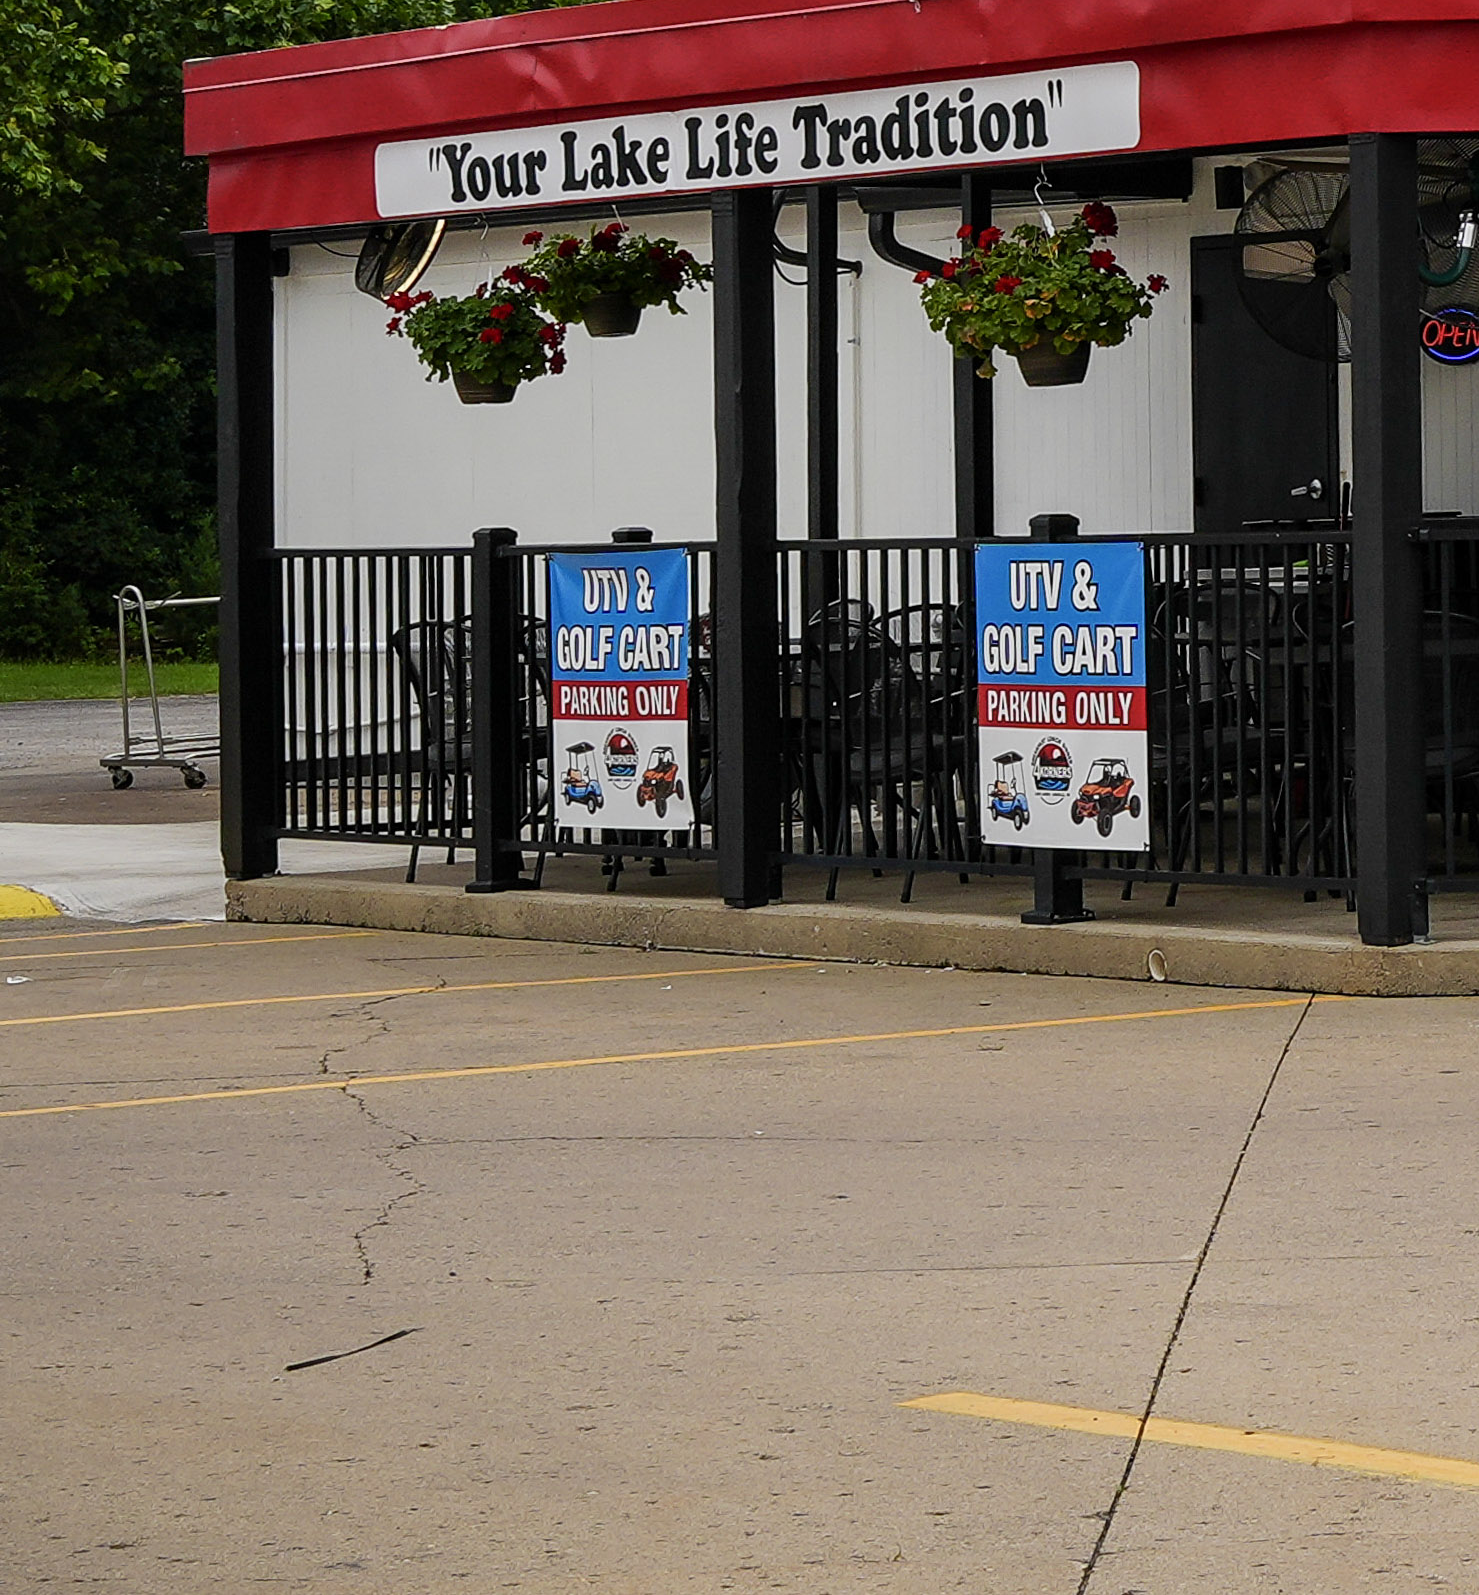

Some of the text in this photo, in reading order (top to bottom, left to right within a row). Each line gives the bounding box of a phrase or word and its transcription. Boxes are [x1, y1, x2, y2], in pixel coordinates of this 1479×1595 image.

[560, 125, 669, 192] Lake
[684, 112, 778, 180] Life
[793, 79, 1062, 169] Tradition"
[582, 566, 655, 612] UTV &
[1009, 559, 1100, 611] UTV &
[557, 623, 684, 671] GOLF CART
[983, 623, 1138, 675] GOLF CART
[560, 685, 679, 715] PARKING ONLY
[987, 690, 1133, 725] PARKING ONLY
